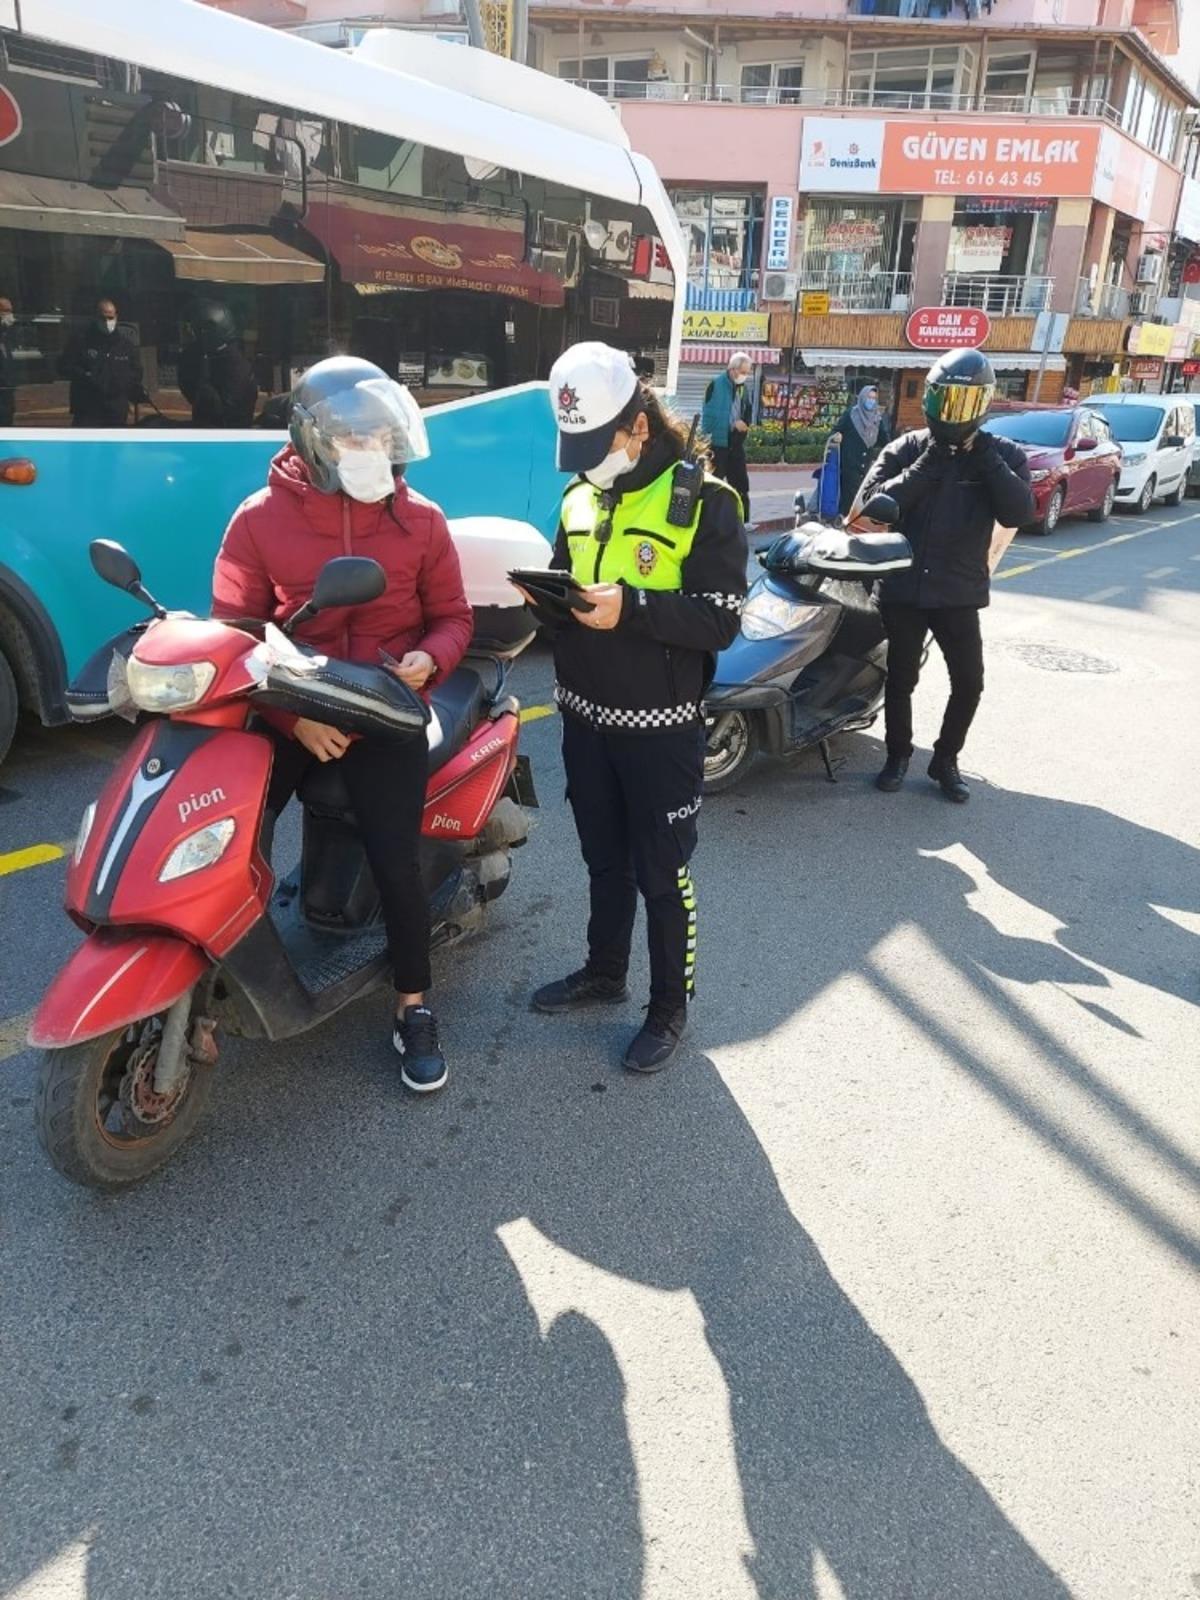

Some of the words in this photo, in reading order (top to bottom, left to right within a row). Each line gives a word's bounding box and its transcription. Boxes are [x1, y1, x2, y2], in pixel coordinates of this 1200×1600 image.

[903, 131, 987, 161] GÜVEN
[996, 138, 1081, 164] EMLAK
[830, 158, 876, 168] DenizBank
[935, 170, 961, 185] TEL:
[966, 170, 994, 186] 616
[999, 171, 1018, 187] 43
[1023, 172, 1042, 187] 45
[937, 313, 962, 326] CAN
[178, 787, 226, 823] pion
[431, 813, 461, 832] pion
